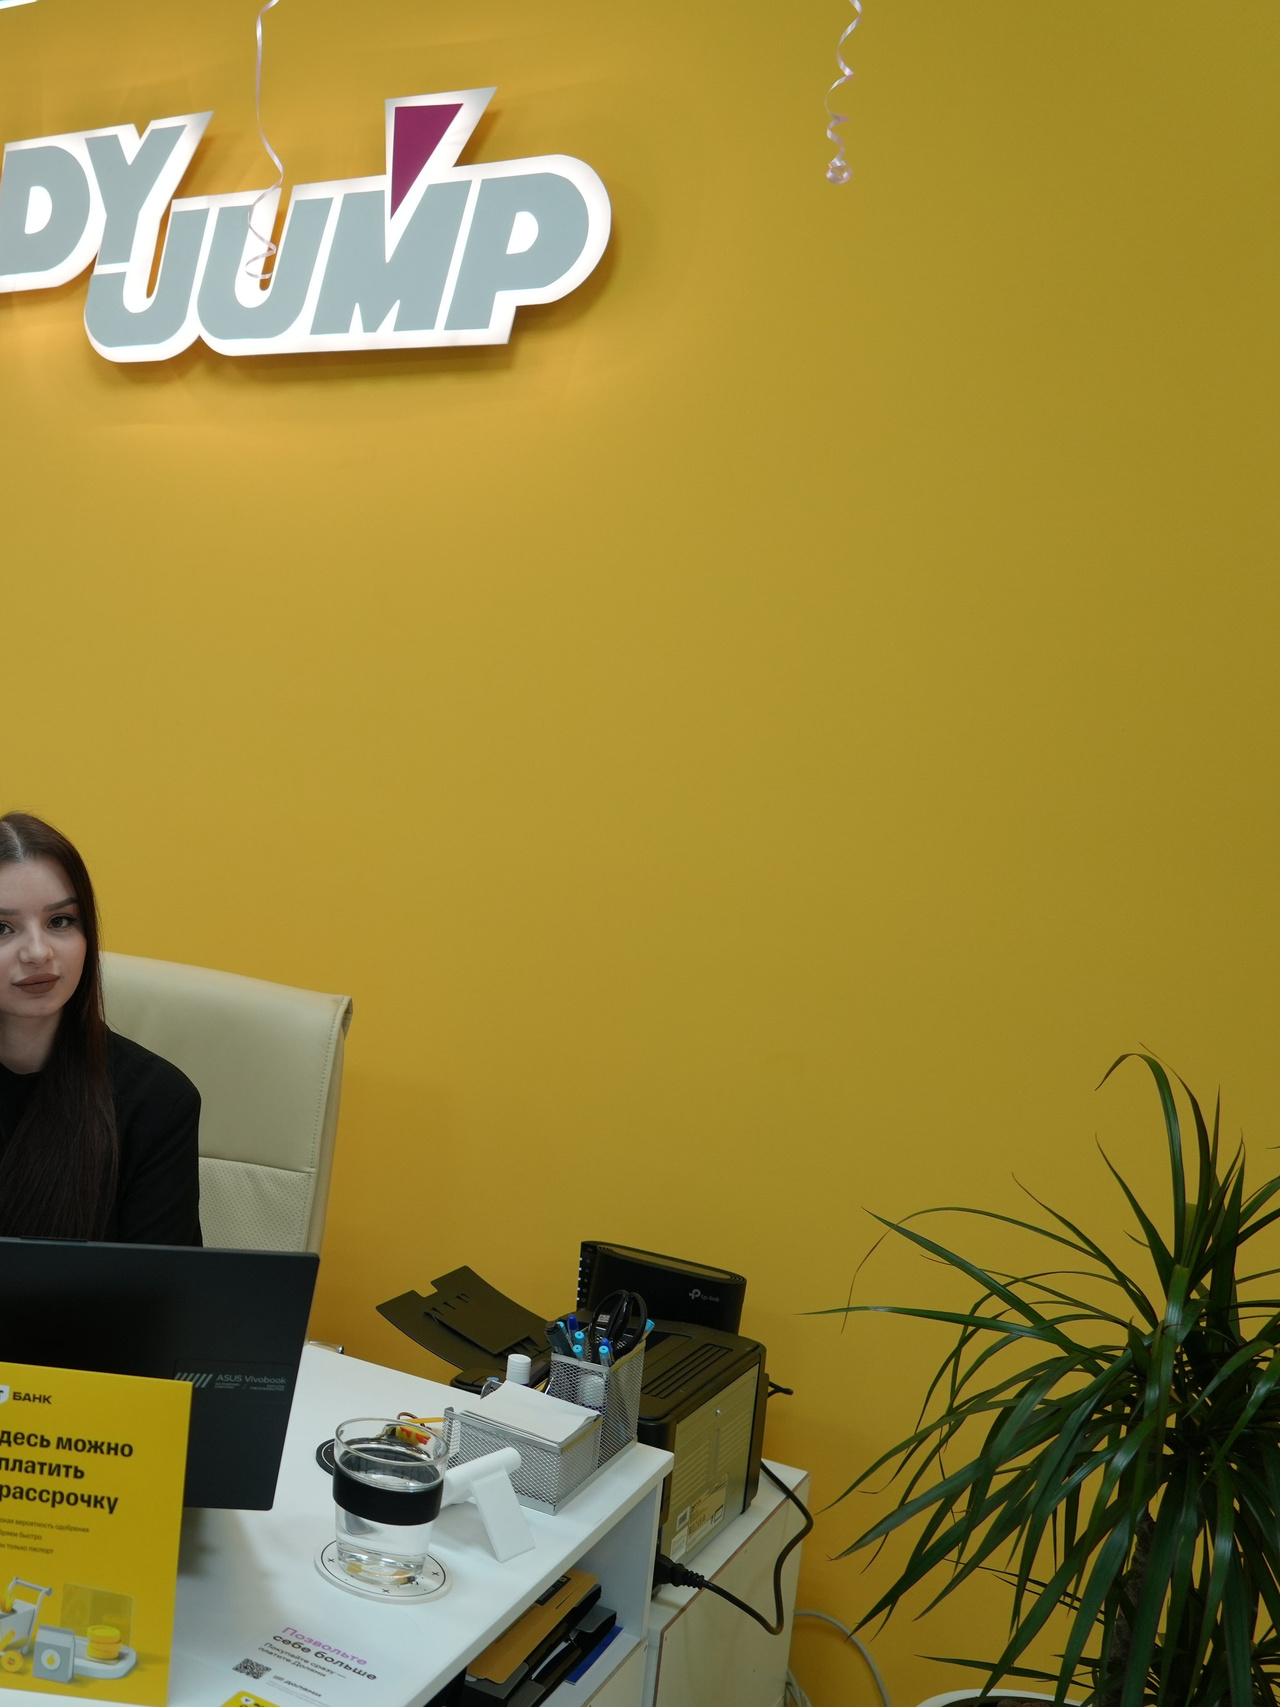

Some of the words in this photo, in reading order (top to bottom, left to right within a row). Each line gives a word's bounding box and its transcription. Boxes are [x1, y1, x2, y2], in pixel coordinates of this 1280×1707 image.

[86, 100, 596, 350] JUMP
[700, 1293, 720, 1304] tp-link
[216, 1374, 242, 1383] ASUS
[244, 1375, 287, 1385] Vivobook
[12, 1391, 52, 1404] БАНК
[56, 1436, 133, 1457] можно
[15, 1519, 54, 1530] вероятность
[55, 1523, 89, 1533] одобрения
[19, 1531, 42, 1541] быстро
[6, 1543, 27, 1551] только
[28, 1546, 54, 1555] паспорт
[281, 1626, 367, 1665] Позвольте
[258, 1647, 292, 1663] платите
[291, 1661, 326, 1677] Долями
[264, 1642, 309, 1664] Покупайте
[310, 1661, 335, 1675] сразу
[273, 1635, 311, 1653] себе
[314, 1650, 377, 1680] больше
